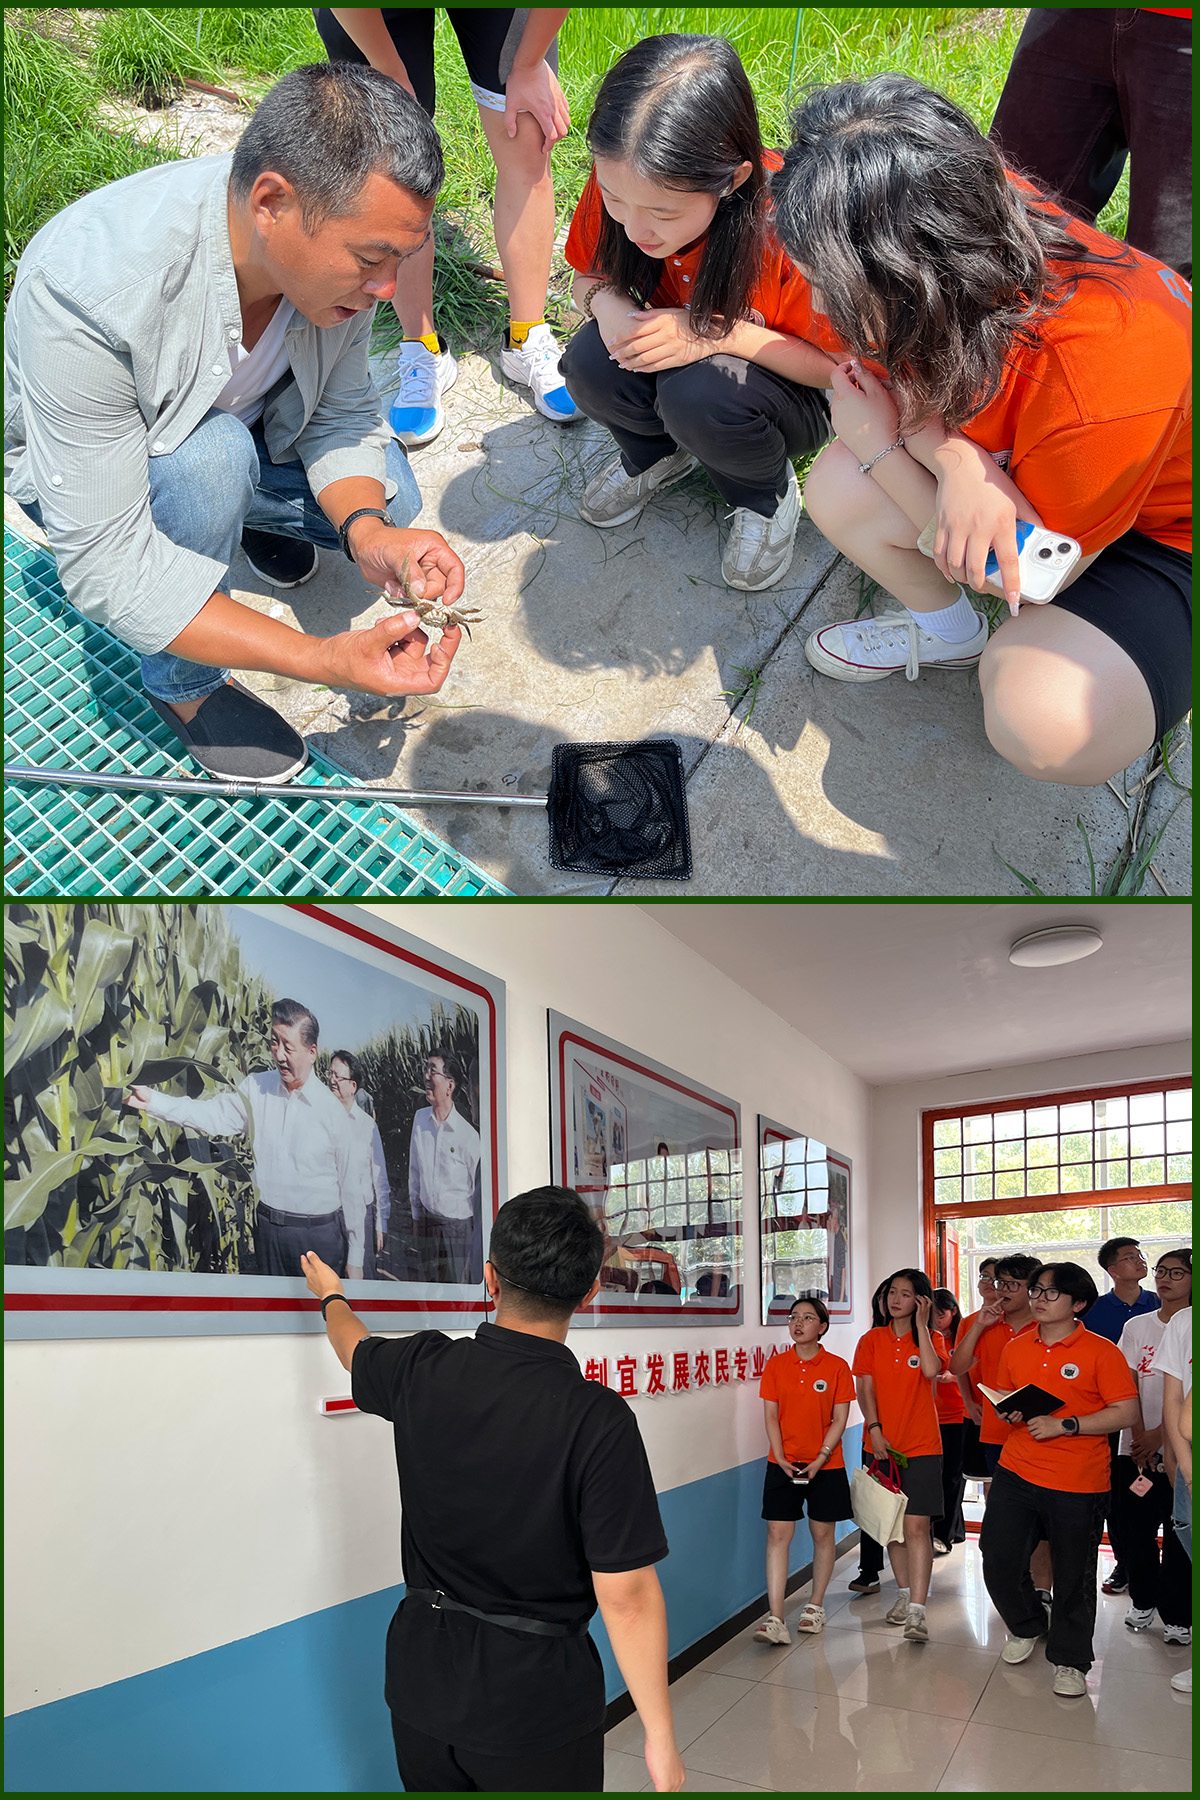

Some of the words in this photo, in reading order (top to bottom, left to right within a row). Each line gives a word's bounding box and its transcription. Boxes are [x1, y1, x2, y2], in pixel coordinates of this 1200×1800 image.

[585, 1344, 791, 1397] 制宜发展农民专业
